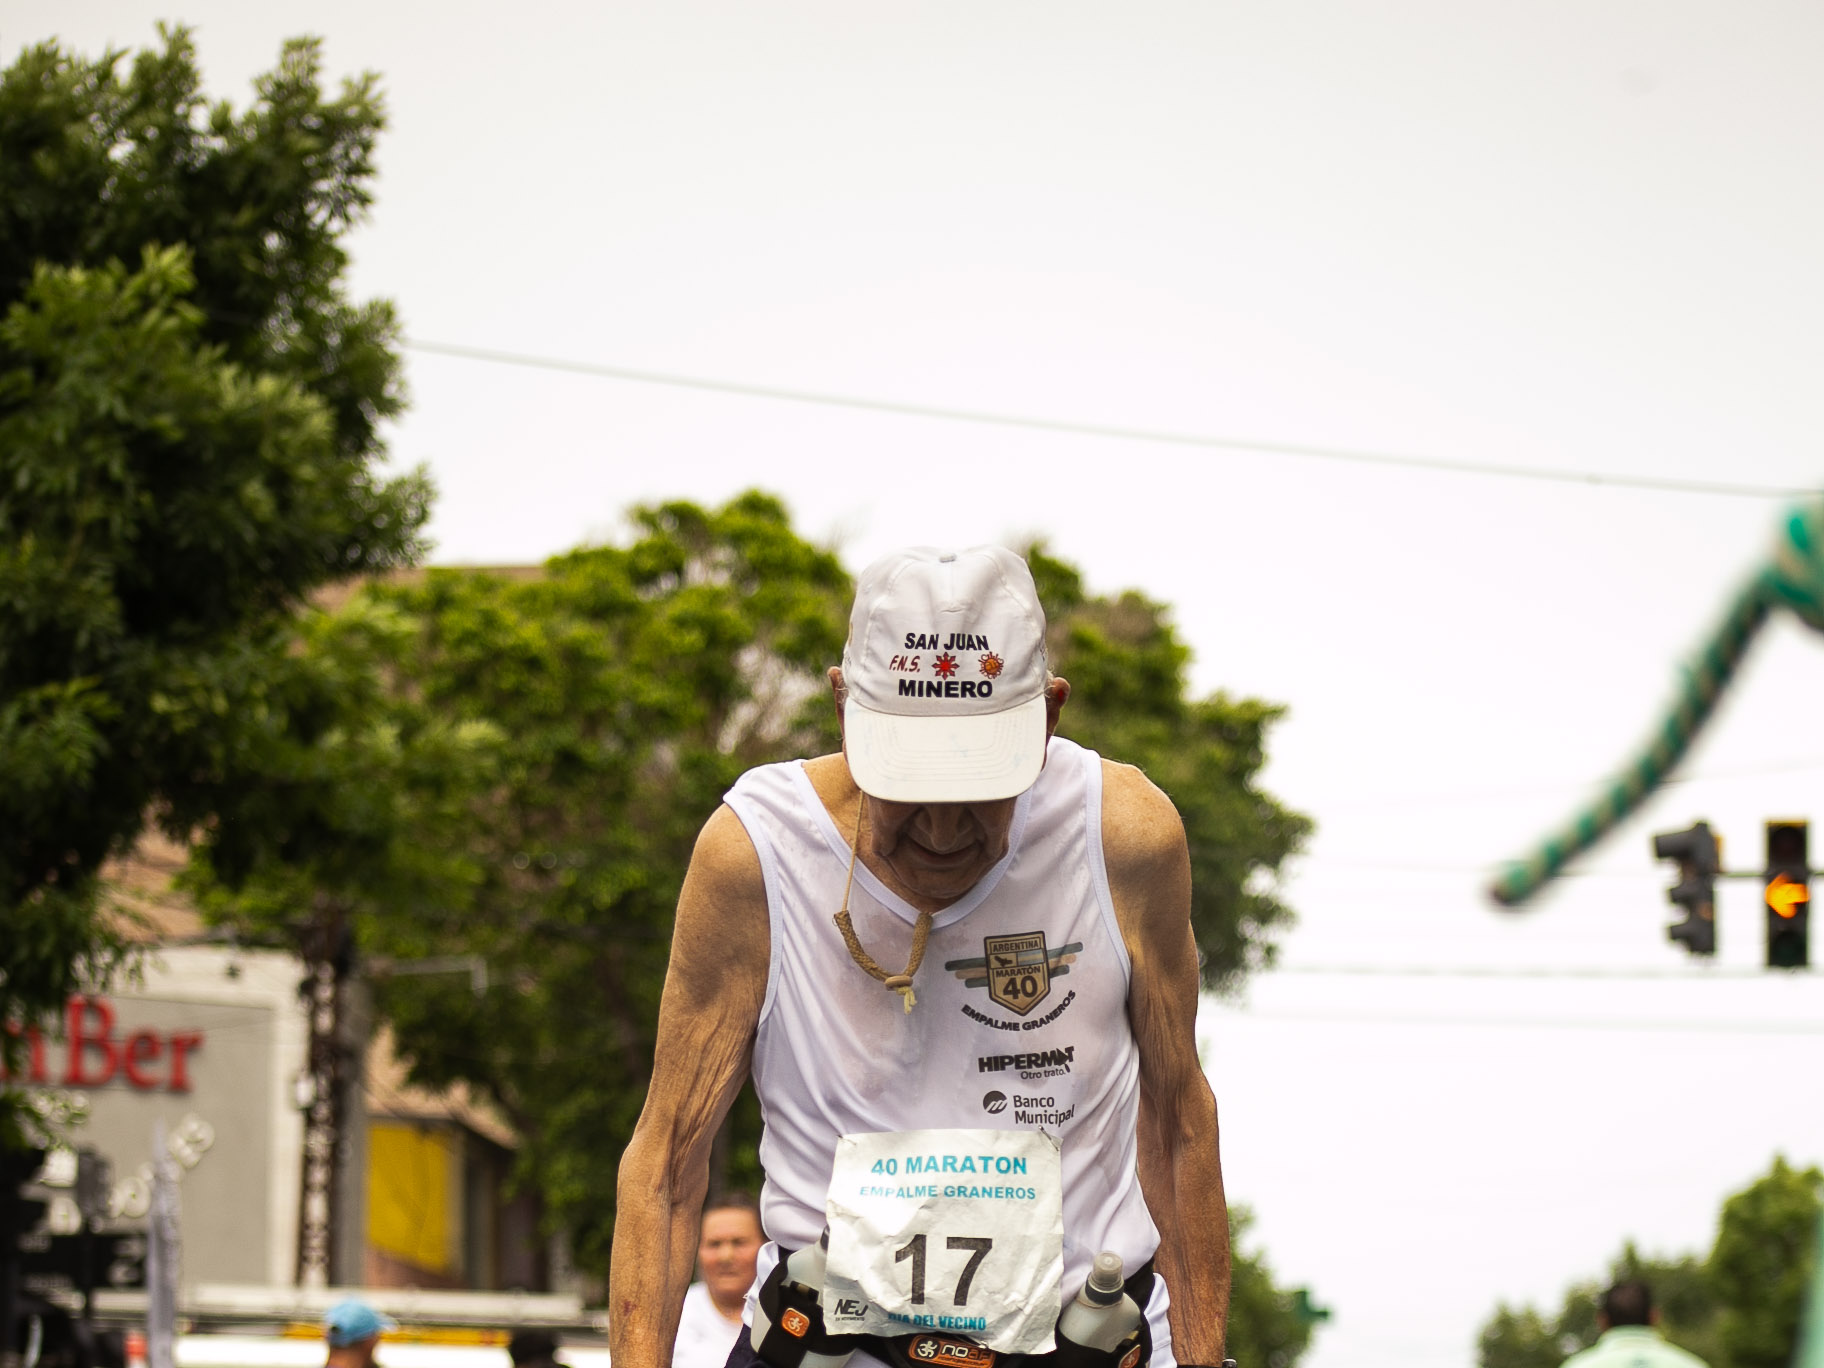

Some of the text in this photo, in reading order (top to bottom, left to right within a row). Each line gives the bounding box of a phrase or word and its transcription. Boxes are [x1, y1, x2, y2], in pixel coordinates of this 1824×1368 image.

[904, 633, 989, 651] SAN JUAN
[889, 655, 921, 673] F.N.S.
[898, 679, 993, 698] MINERO
[993, 940, 1039, 952] ARGENTINA
[1003, 976, 1038, 999] 40
[961, 990, 1076, 1031] EMPALME GRANEROS
[1020, 1071, 1042, 1079] Otro
[1013, 1095, 1055, 1108] Banco
[1015, 1104, 1075, 1127] Municipal
[871, 1155, 1027, 1176] 40 MARATON
[860, 1185, 1036, 1199] EMPALME GRANEROS
[895, 1233, 993, 1306] 17
[914, 1314, 935, 1328] DEL
[938, 1316, 986, 1330] VECINO
